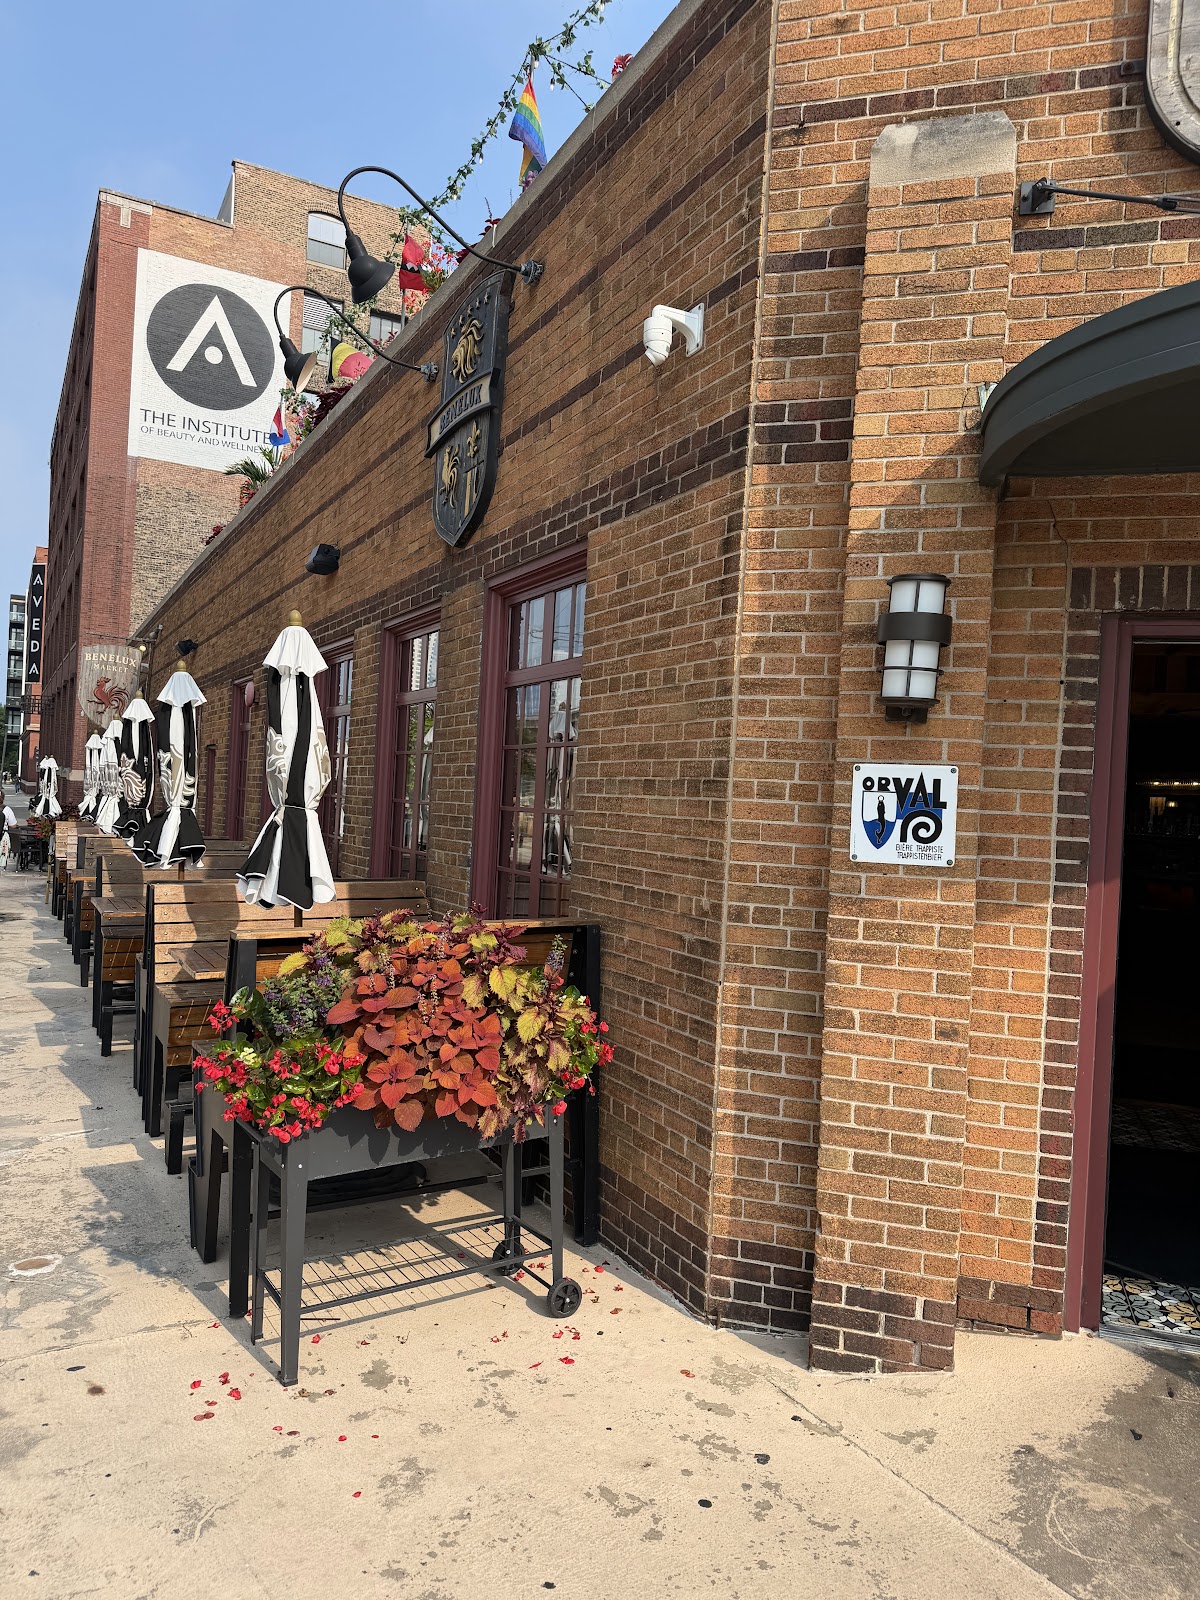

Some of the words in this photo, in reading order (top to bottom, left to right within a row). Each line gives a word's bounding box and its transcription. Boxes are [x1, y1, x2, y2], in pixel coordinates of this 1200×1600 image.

[439, 384, 483, 435] BENELUX
[140, 408, 176, 428] THE
[182, 416, 272, 445] INSTITUTE
[140, 425, 154, 434] OF
[157, 428, 195, 442] BEAUTY
[198, 436, 219, 446] AND
[221, 440, 270, 454] WELLNE
[28, 573, 44, 675] AVEDA
[84, 652, 137, 667] BENELUX
[93, 663, 129, 673] MARKET
[862, 771, 947, 814] ORVAL
[897, 851, 942, 861] TRAPPISTENBIER
[916, 844, 944, 853] TRAPPISTE
